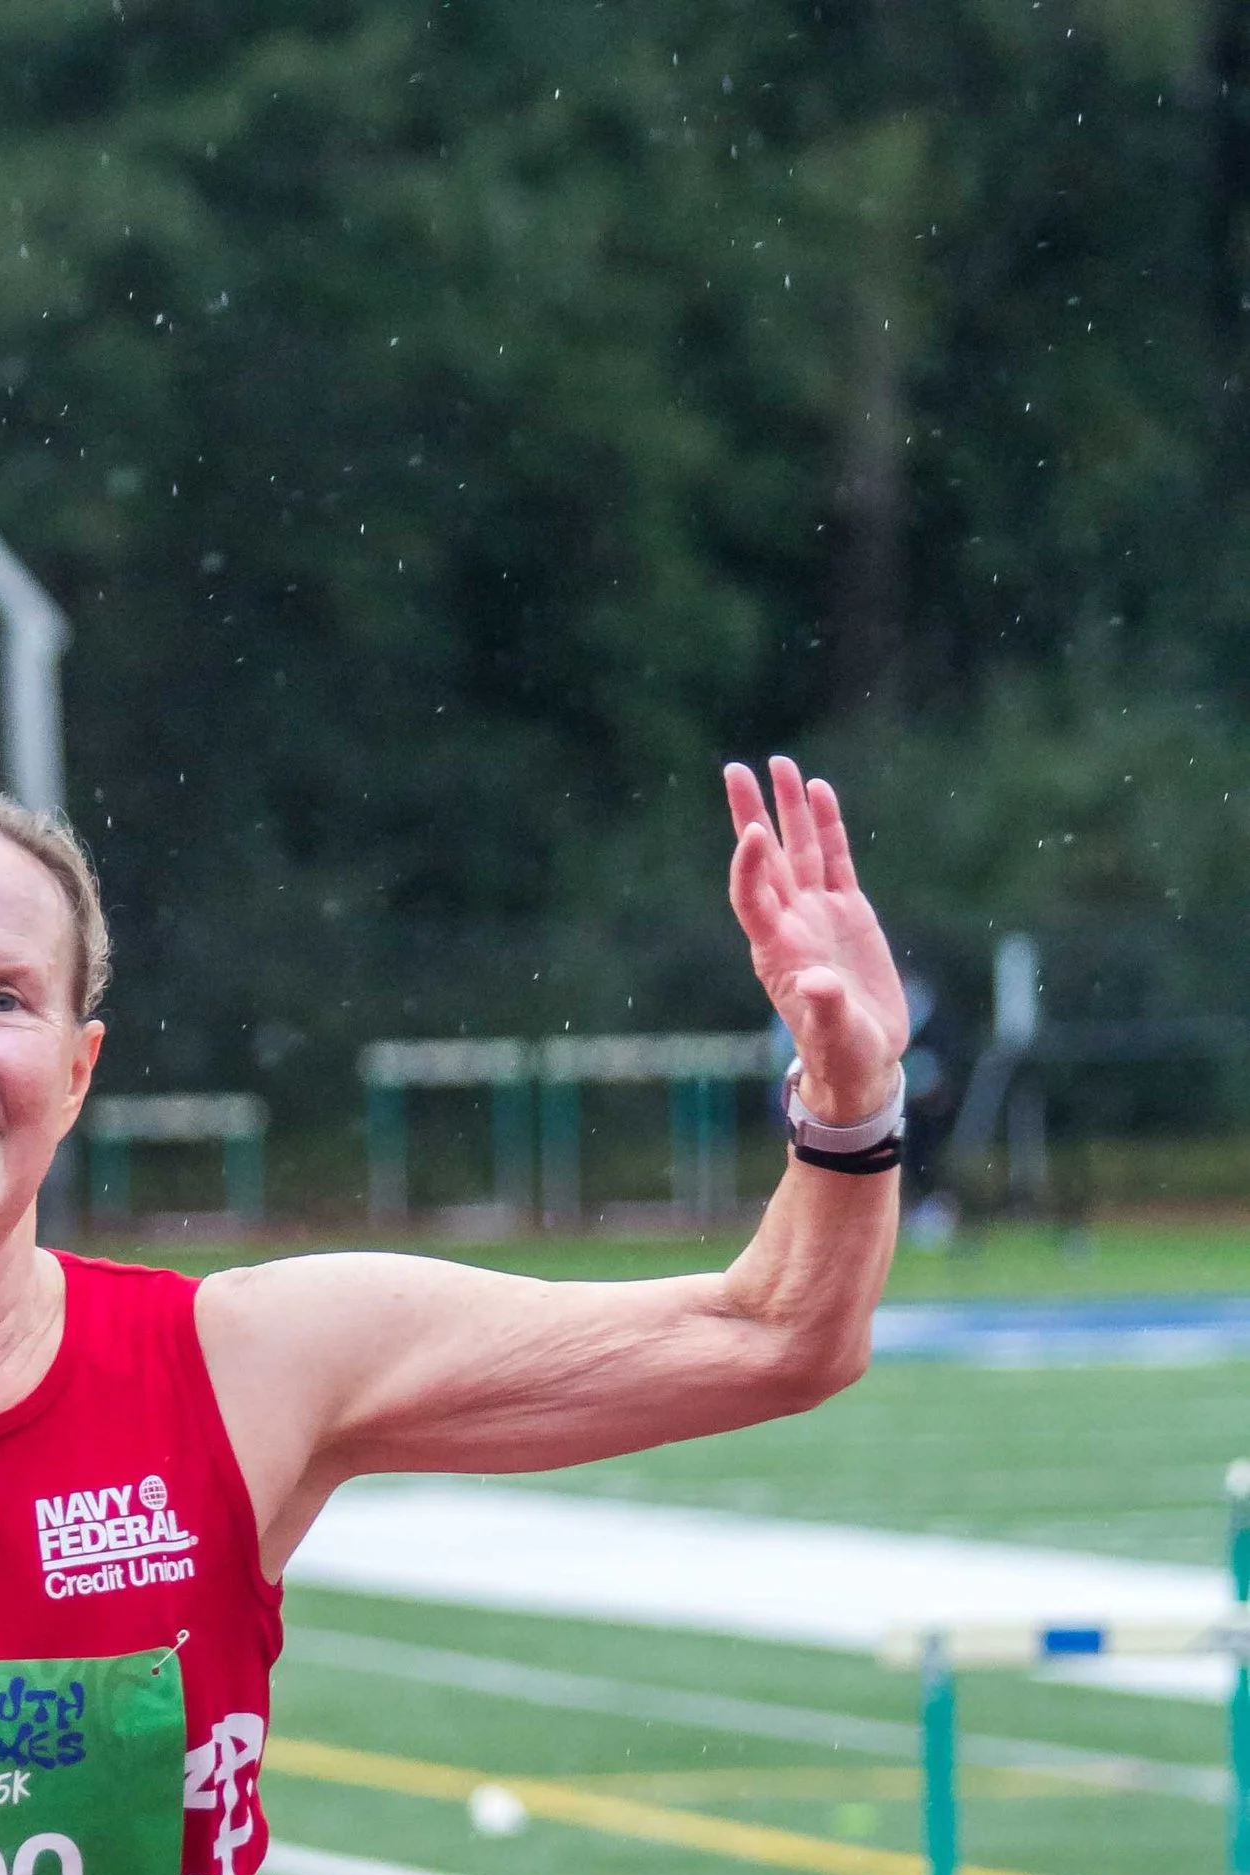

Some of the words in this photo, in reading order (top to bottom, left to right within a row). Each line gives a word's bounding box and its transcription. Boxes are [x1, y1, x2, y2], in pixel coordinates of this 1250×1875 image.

[35, 1485, 133, 1530] NAVY
[38, 1509, 190, 1562] FEDERAL
[44, 1564, 126, 1600] Credit
[128, 1555, 196, 1588] Union
